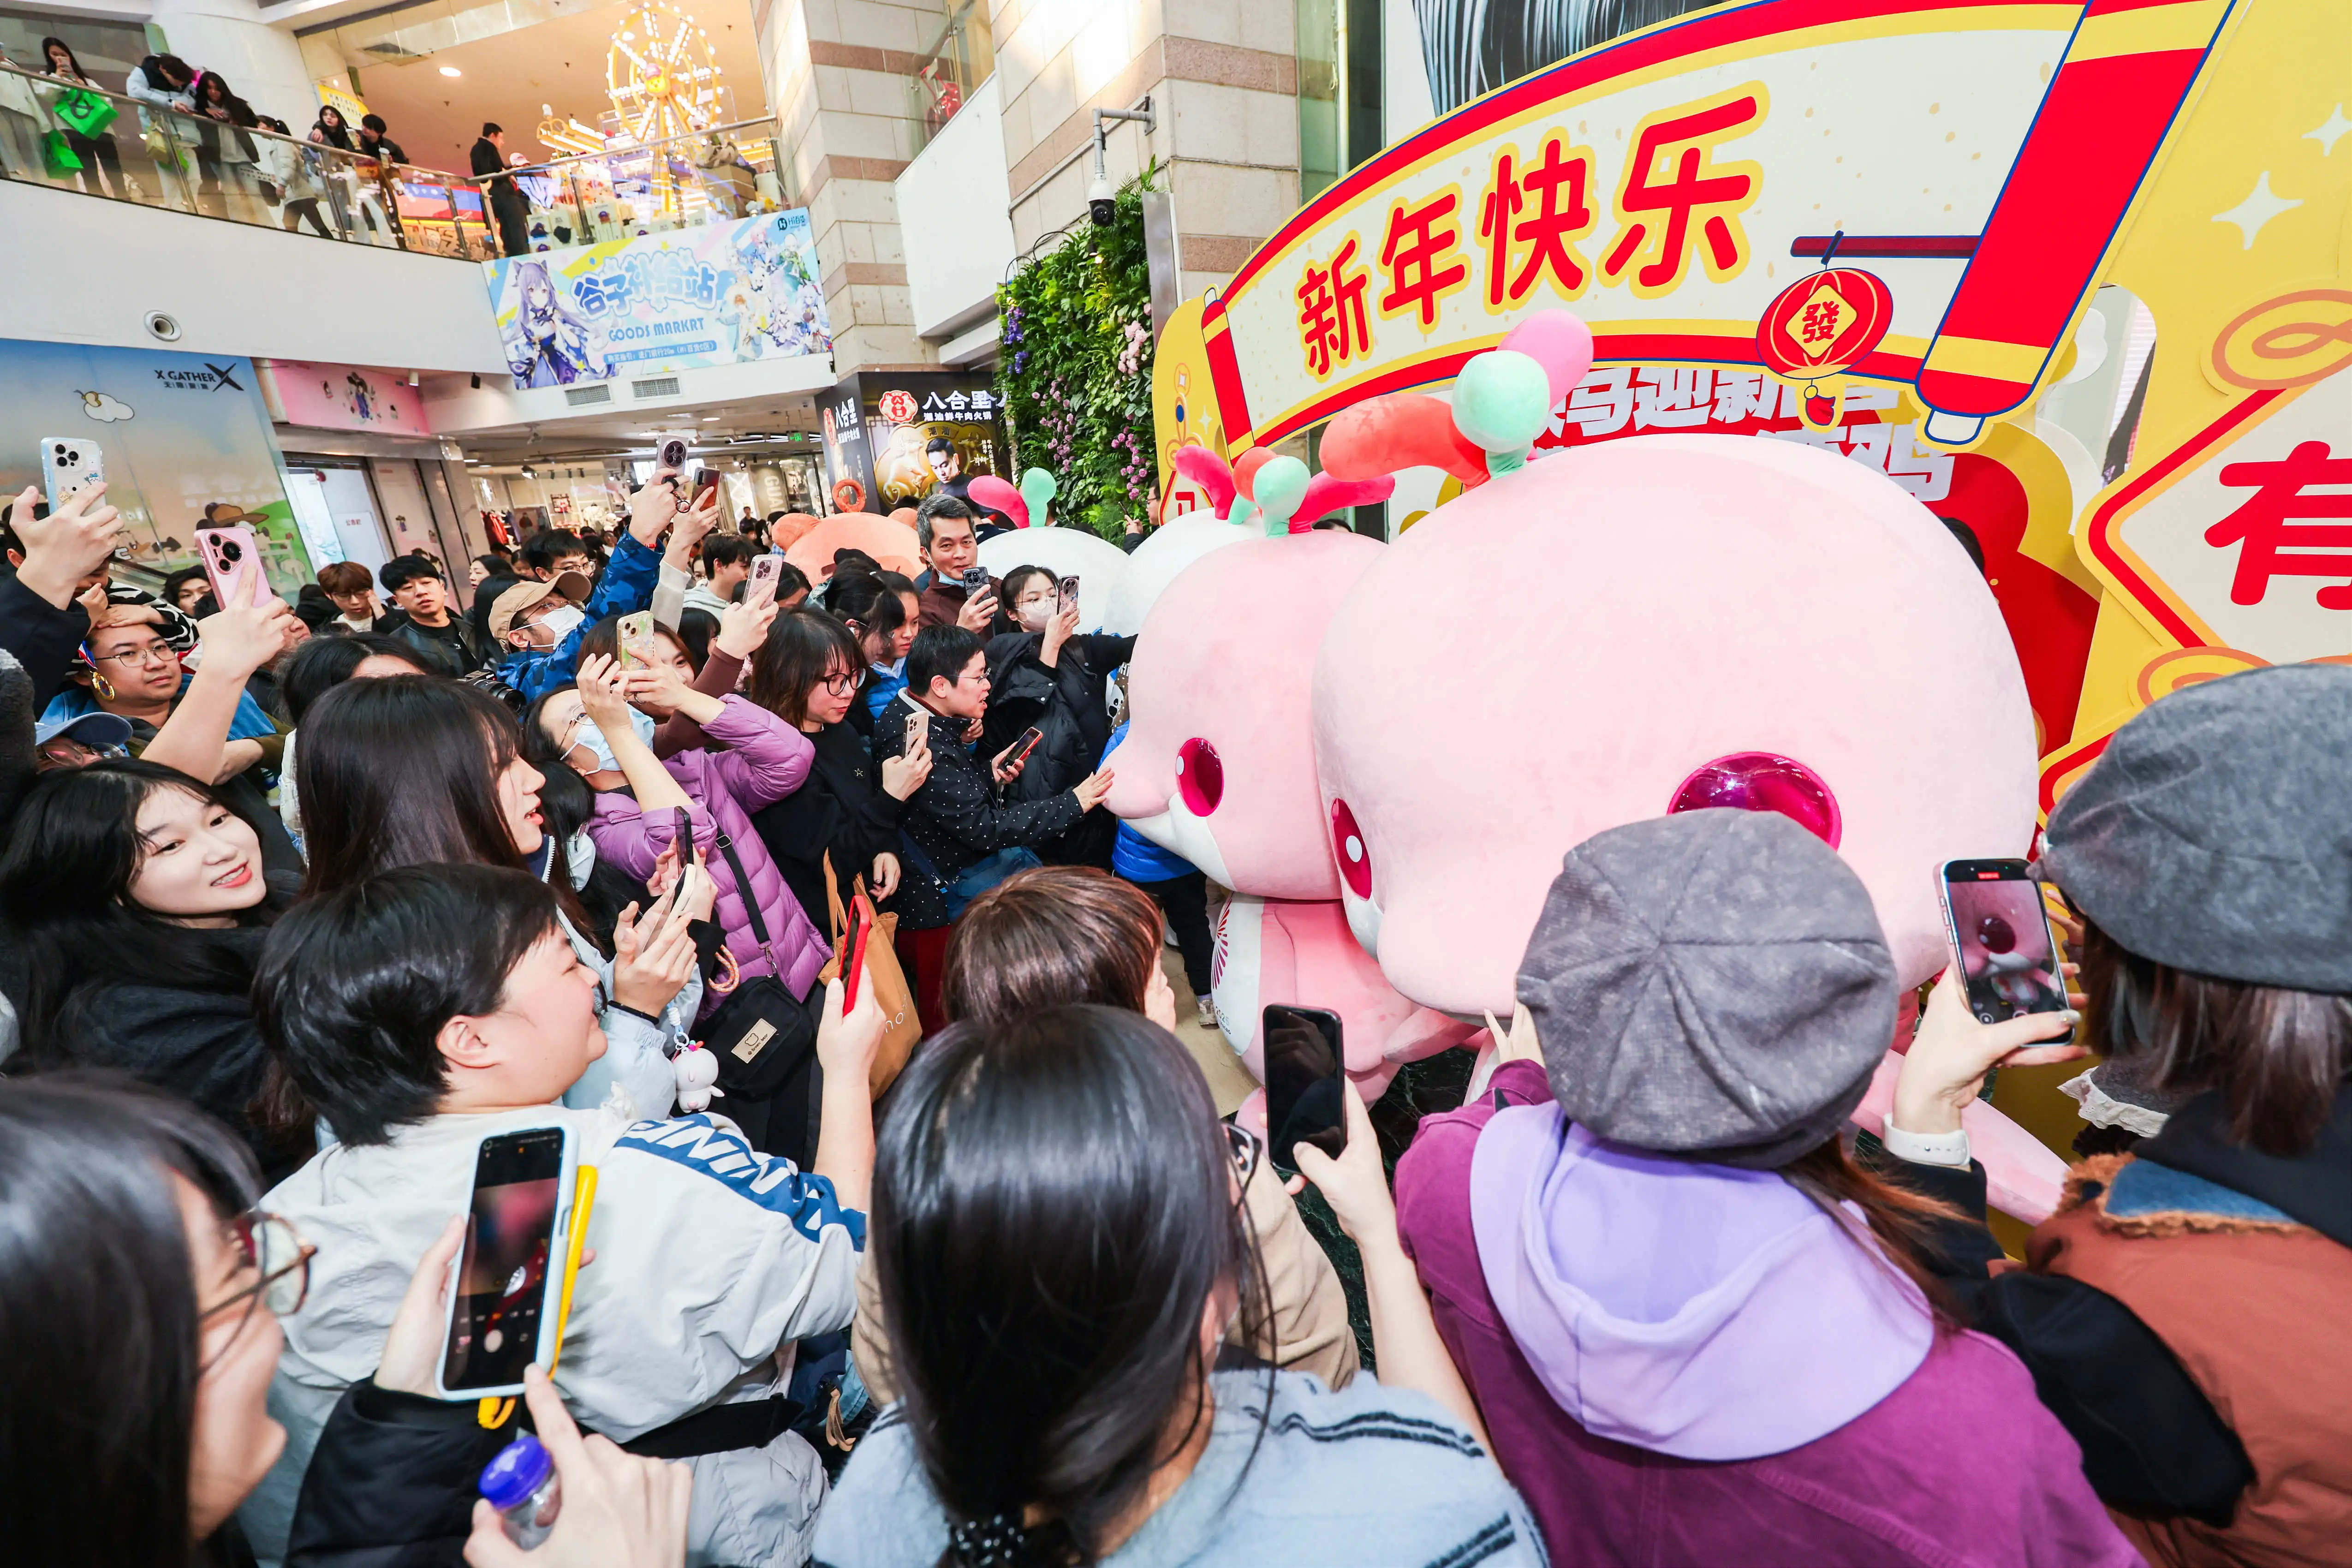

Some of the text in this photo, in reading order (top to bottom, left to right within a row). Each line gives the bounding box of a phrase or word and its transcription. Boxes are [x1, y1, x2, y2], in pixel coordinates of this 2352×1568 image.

[1298, 95, 1758, 375] 新年快乐
[574, 254, 715, 316] 谷子补给站
[608, 324, 650, 342] GOODS
[1802, 300, 1840, 344] 發
[167, 370, 216, 382] GATHER
[923, 411, 992, 422] 潮汕鲜牛肉火锅
